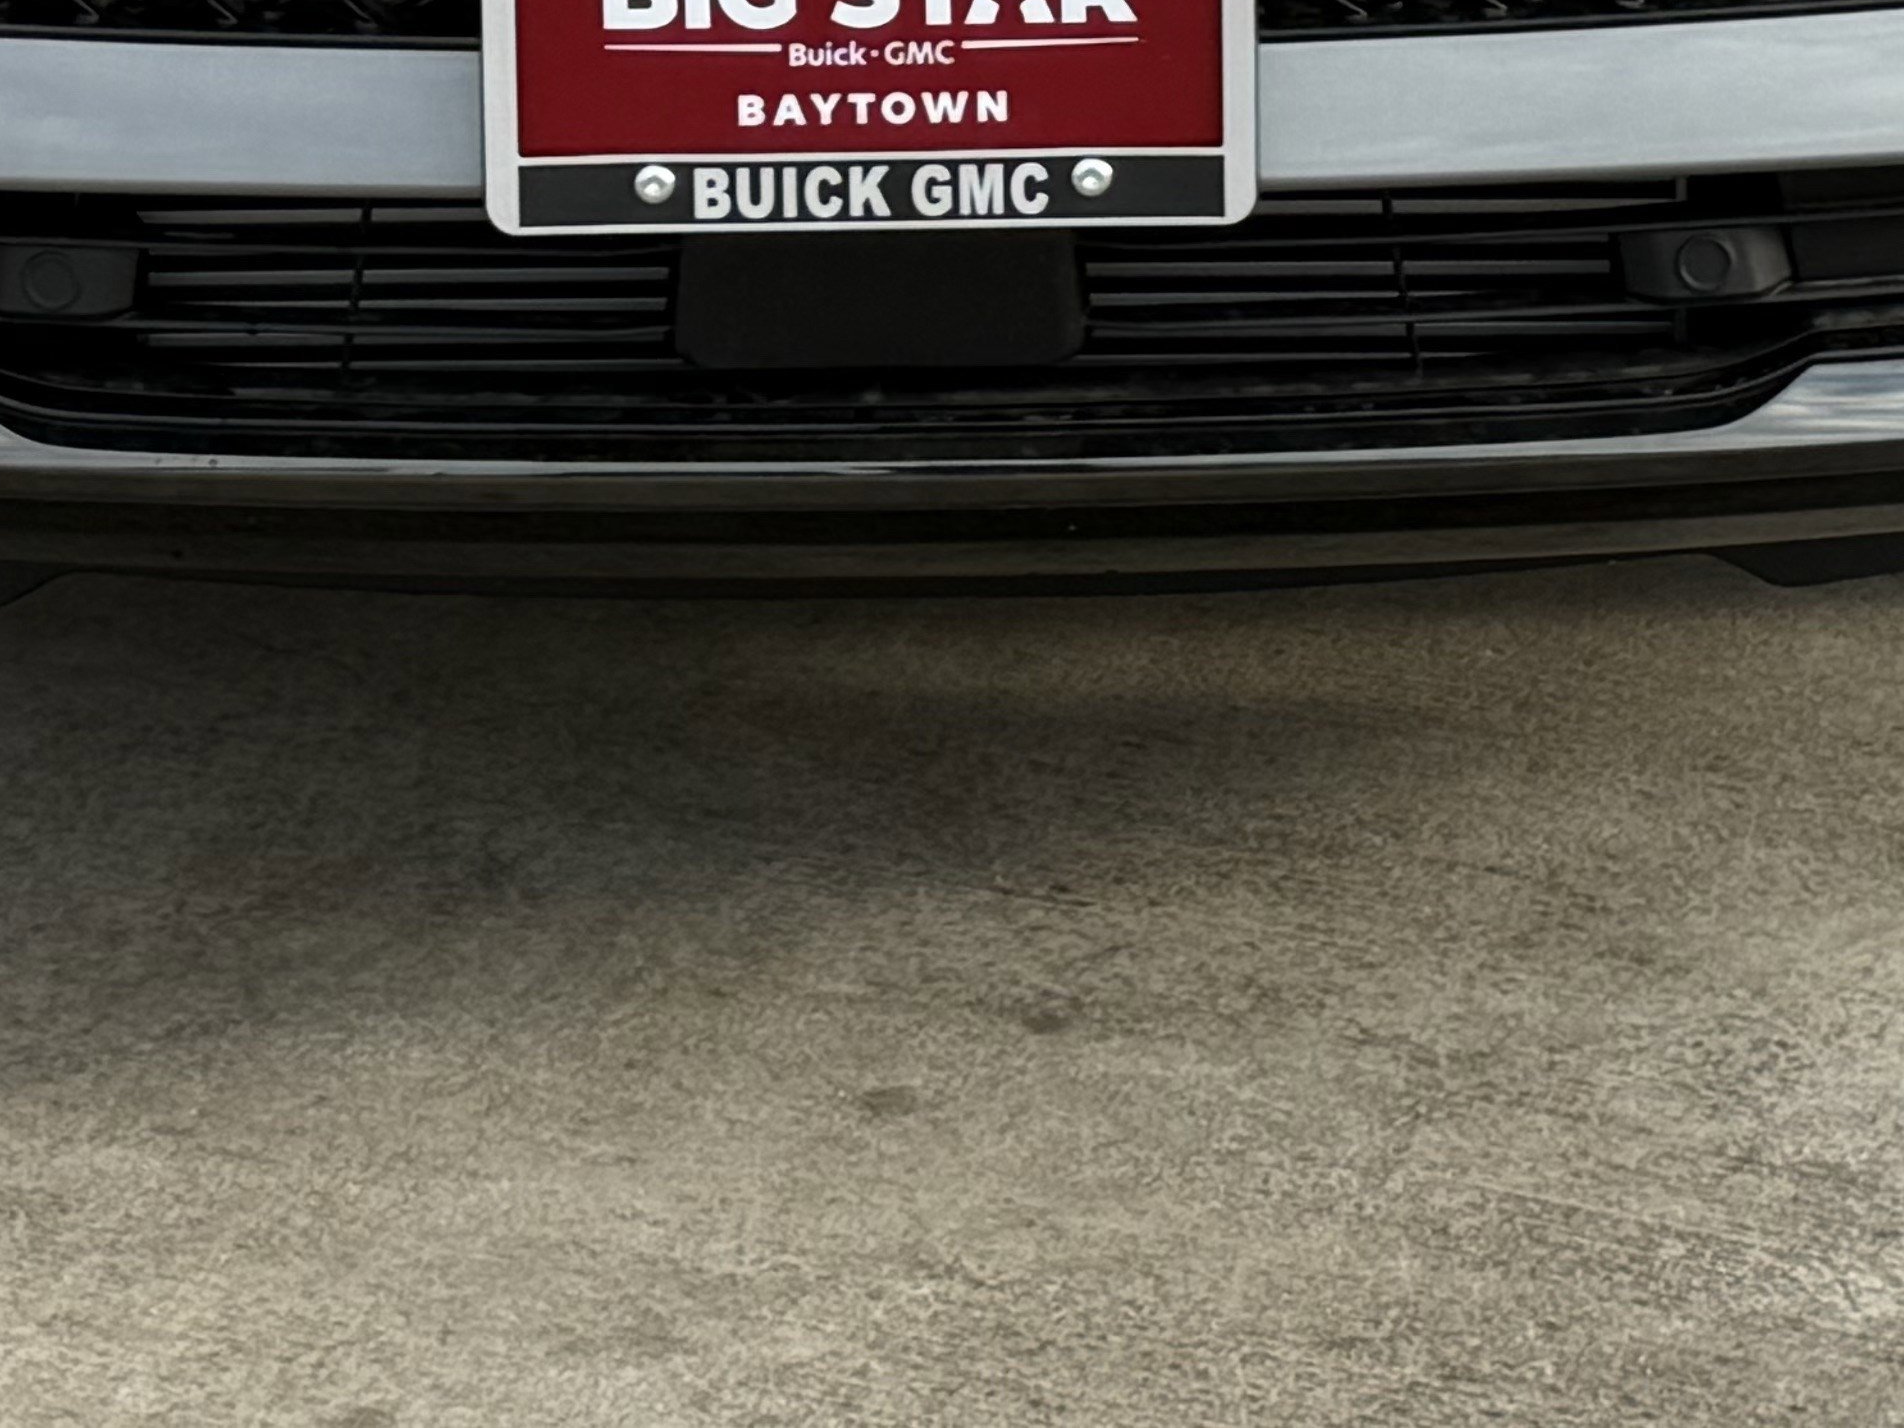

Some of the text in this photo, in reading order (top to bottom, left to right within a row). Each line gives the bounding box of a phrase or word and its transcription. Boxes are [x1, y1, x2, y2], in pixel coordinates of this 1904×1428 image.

[788, 40, 955, 67] Buick GMC
[737, 90, 1009, 127] BAYTOWN
[694, 162, 1050, 220] BUICK GMC
